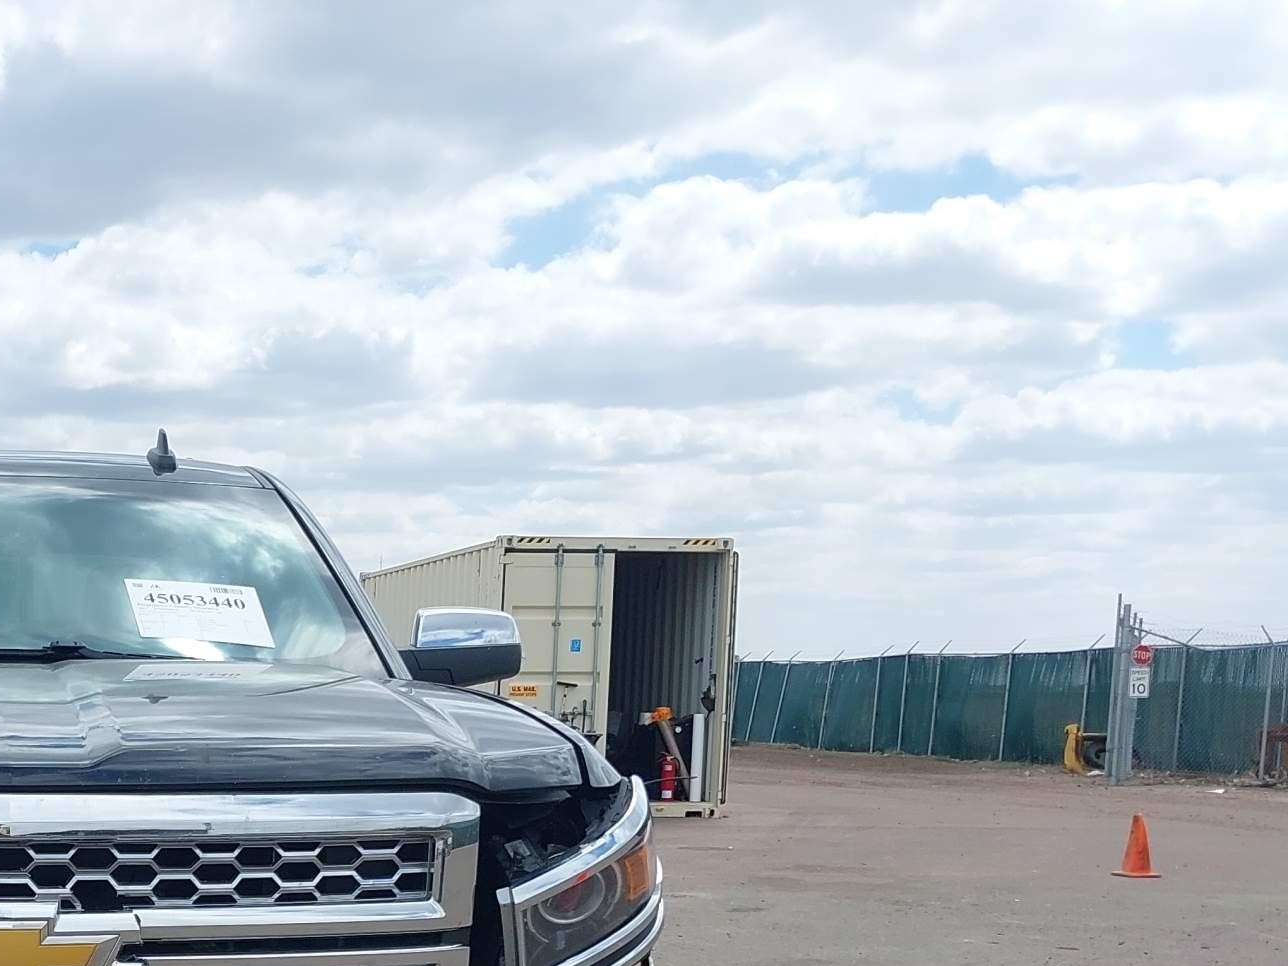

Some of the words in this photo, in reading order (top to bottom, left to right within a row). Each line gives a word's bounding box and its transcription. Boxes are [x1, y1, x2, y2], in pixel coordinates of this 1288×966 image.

[144, 592, 246, 610] 45053440
[1133, 650, 1151, 660] STOP
[1132, 683, 1146, 694] 10
